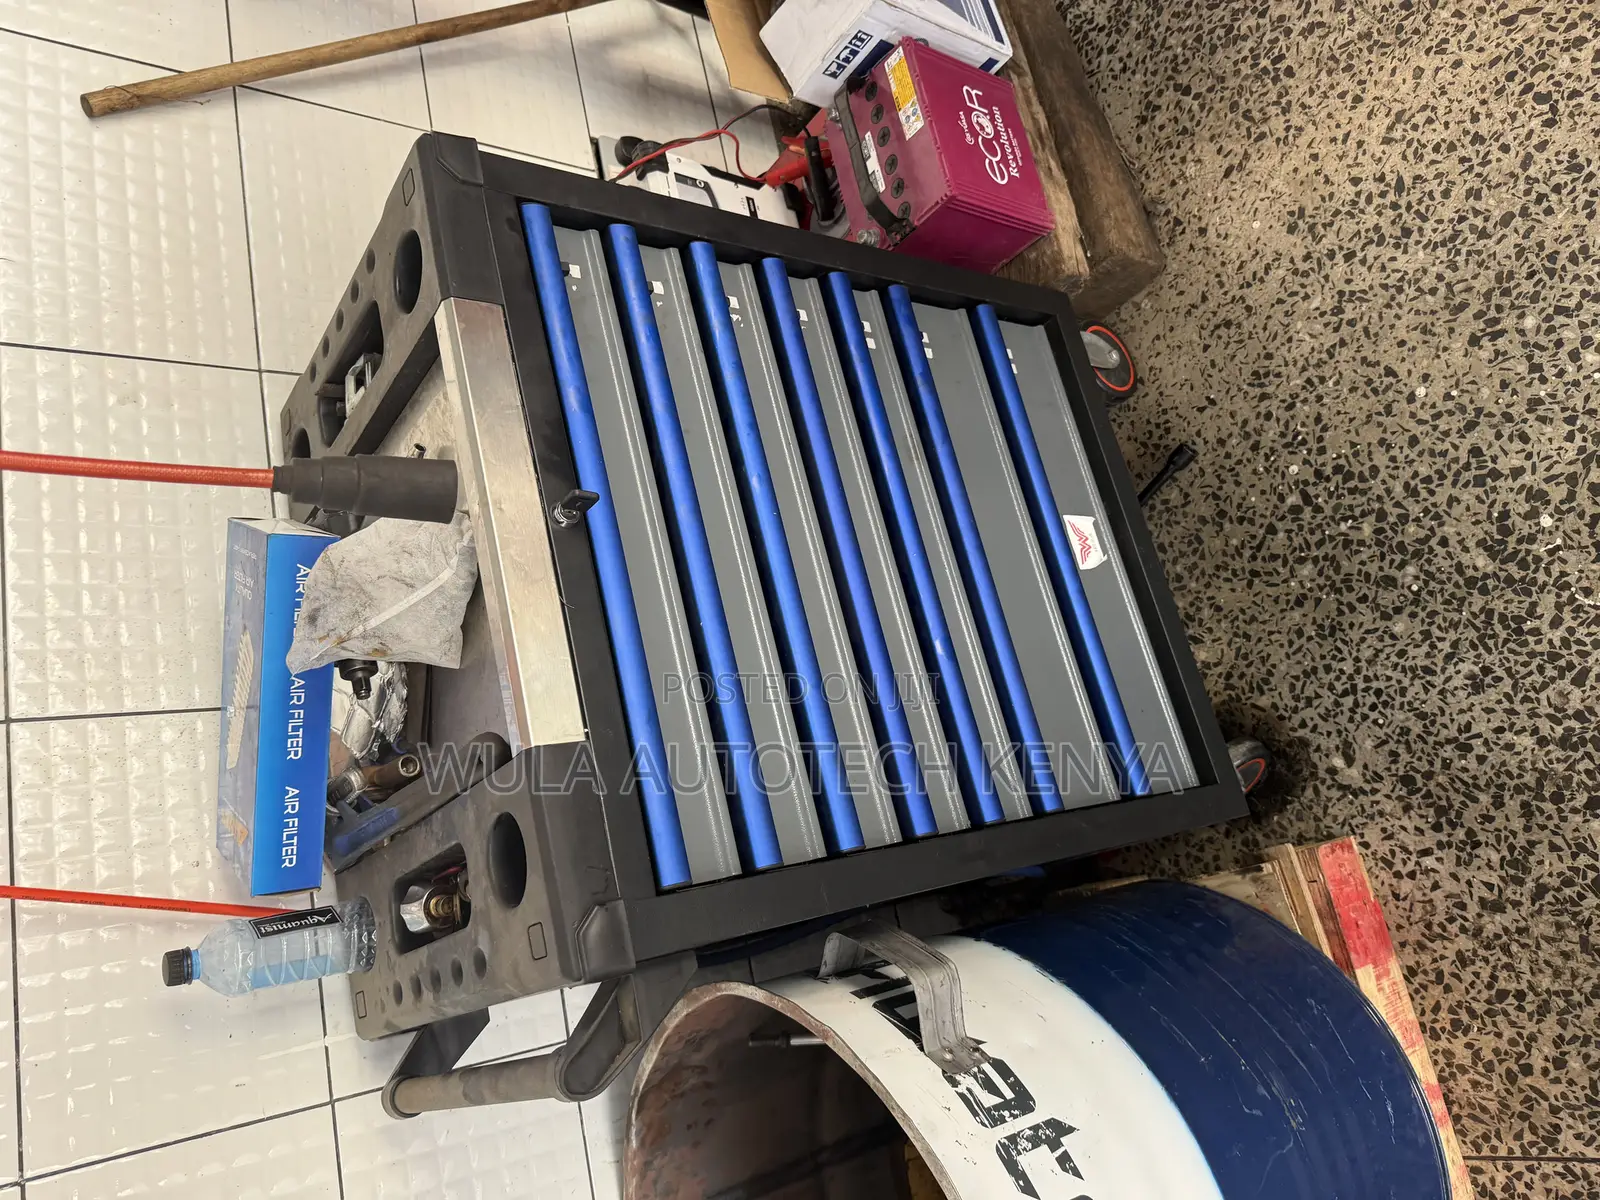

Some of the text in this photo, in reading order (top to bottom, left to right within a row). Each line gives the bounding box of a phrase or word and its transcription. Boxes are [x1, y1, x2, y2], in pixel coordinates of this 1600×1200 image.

[992, 106, 1020, 178] Revolution
[296, 563, 311, 593] AIR
[286, 675, 305, 760] AIR FILTER
[281, 786, 300, 868] AIR FILTER
[260, 913, 333, 934] Aquamist
